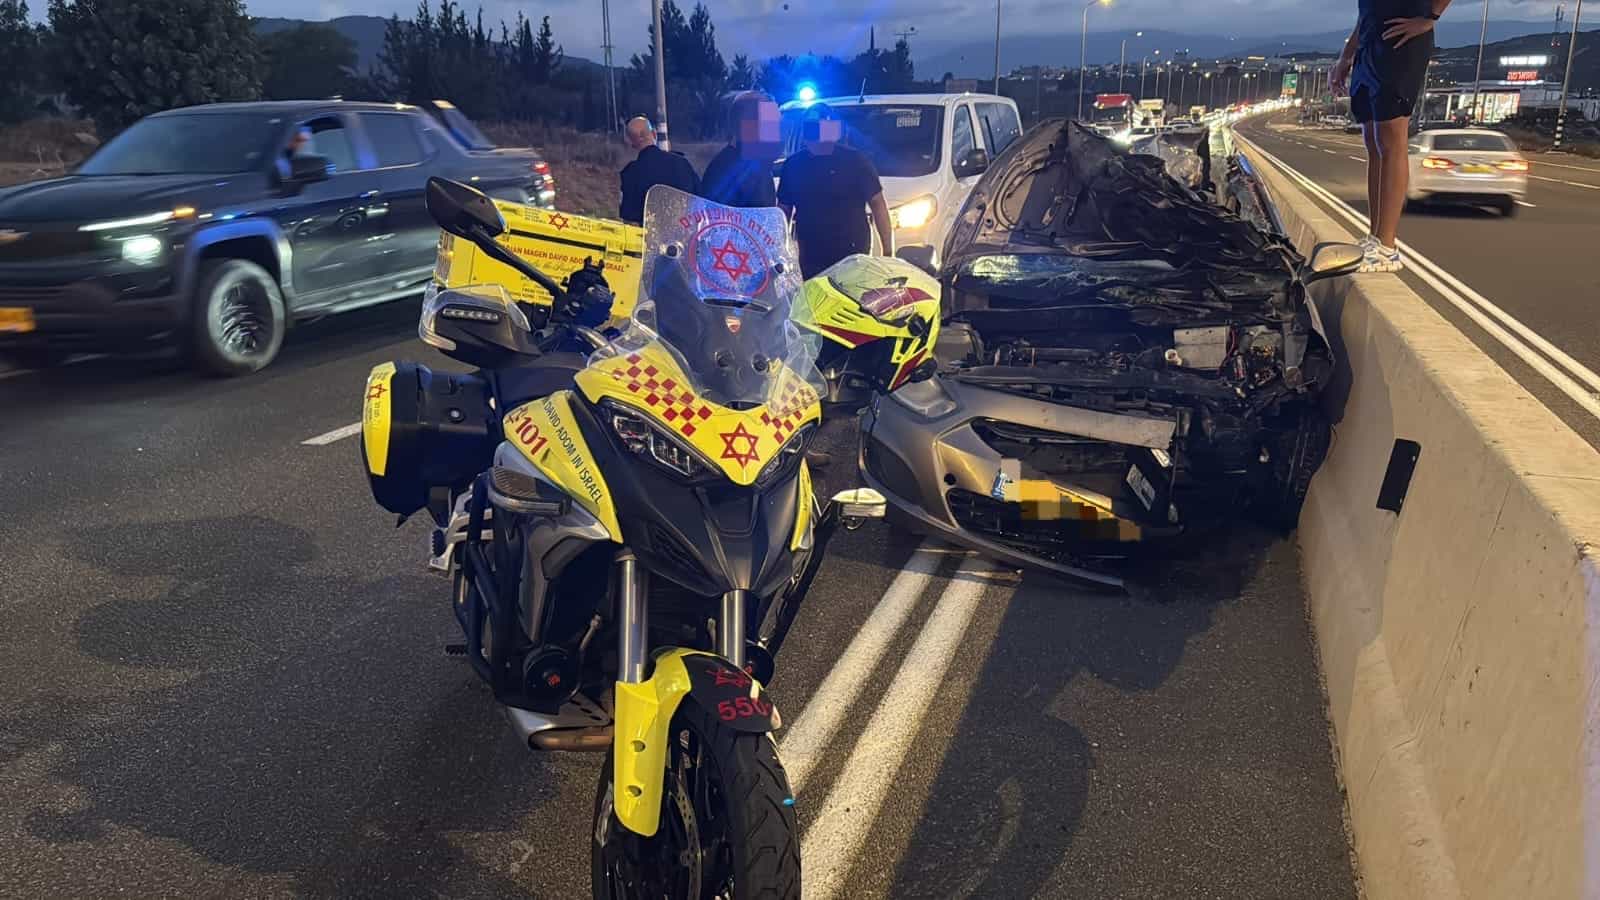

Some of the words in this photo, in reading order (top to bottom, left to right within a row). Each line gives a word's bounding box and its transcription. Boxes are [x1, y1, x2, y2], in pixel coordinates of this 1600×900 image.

[523, 247, 548, 260] MAGEN
[549, 252, 569, 263] DAVID
[570, 256, 586, 265] ADO
[515, 416, 549, 456] 101
[543, 400, 561, 428] DAVID
[556, 426, 577, 457] ADOM
[571, 453, 584, 469] IN
[579, 467, 604, 505] ISRAEL
